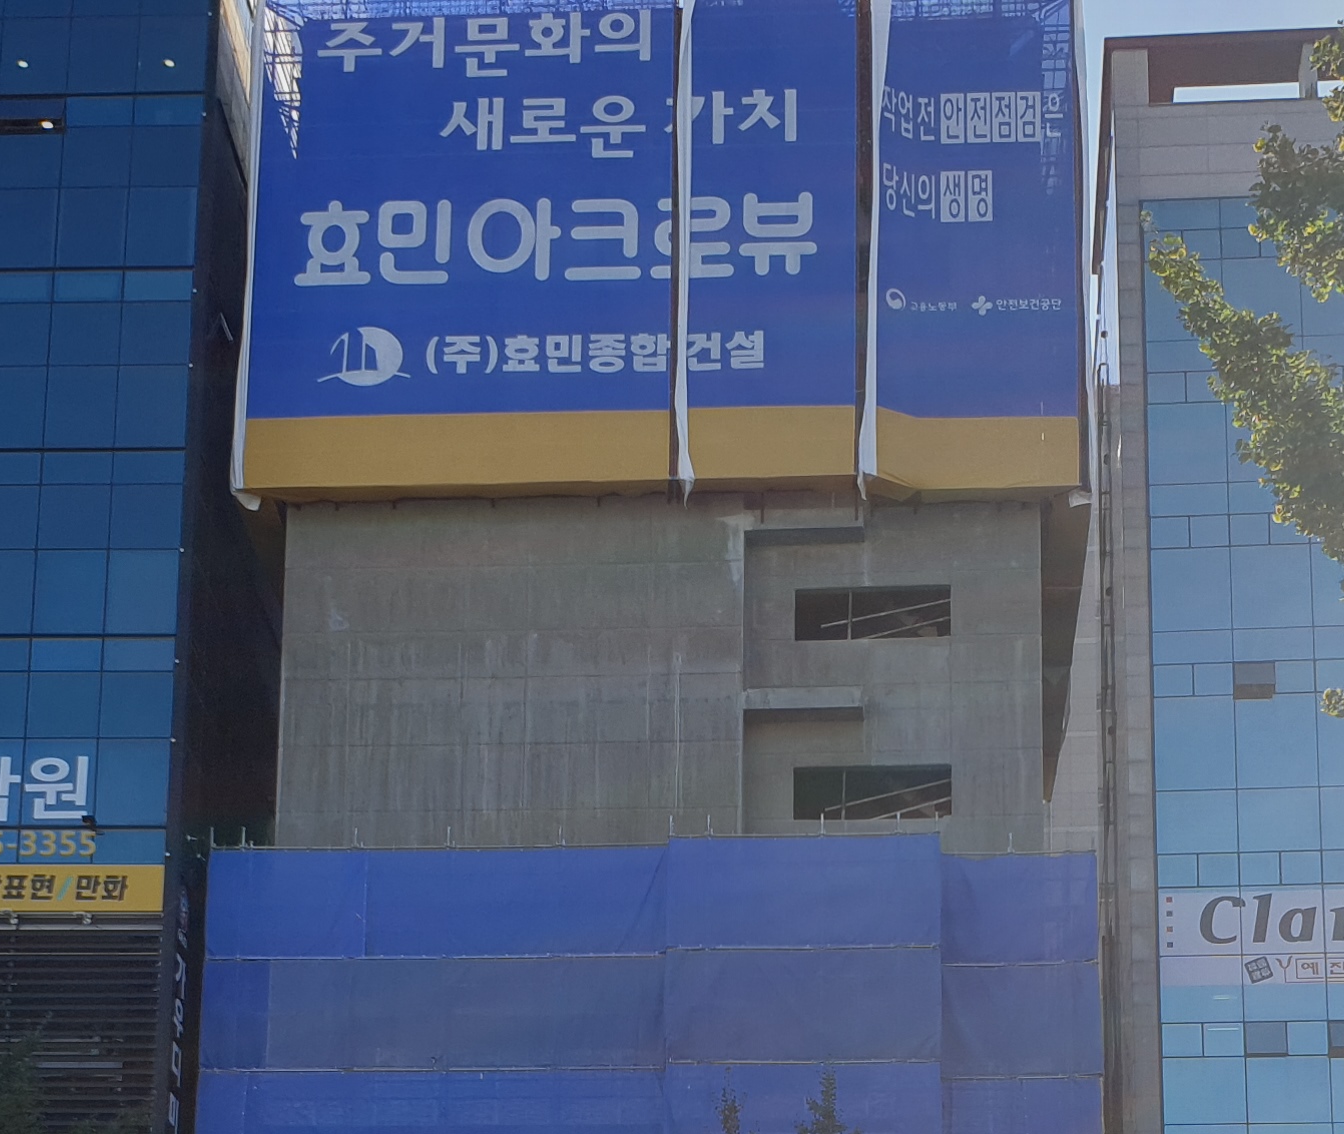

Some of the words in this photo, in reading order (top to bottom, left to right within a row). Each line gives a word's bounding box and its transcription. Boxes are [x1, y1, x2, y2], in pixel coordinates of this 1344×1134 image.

[317, 11, 651, 77] 주거문화의
[440, 95, 646, 158] 새로운
[883, 163, 936, 219] 당신의
[940, 170, 993, 222] 생명
[996, 298, 1062, 311] 안전보건공단
